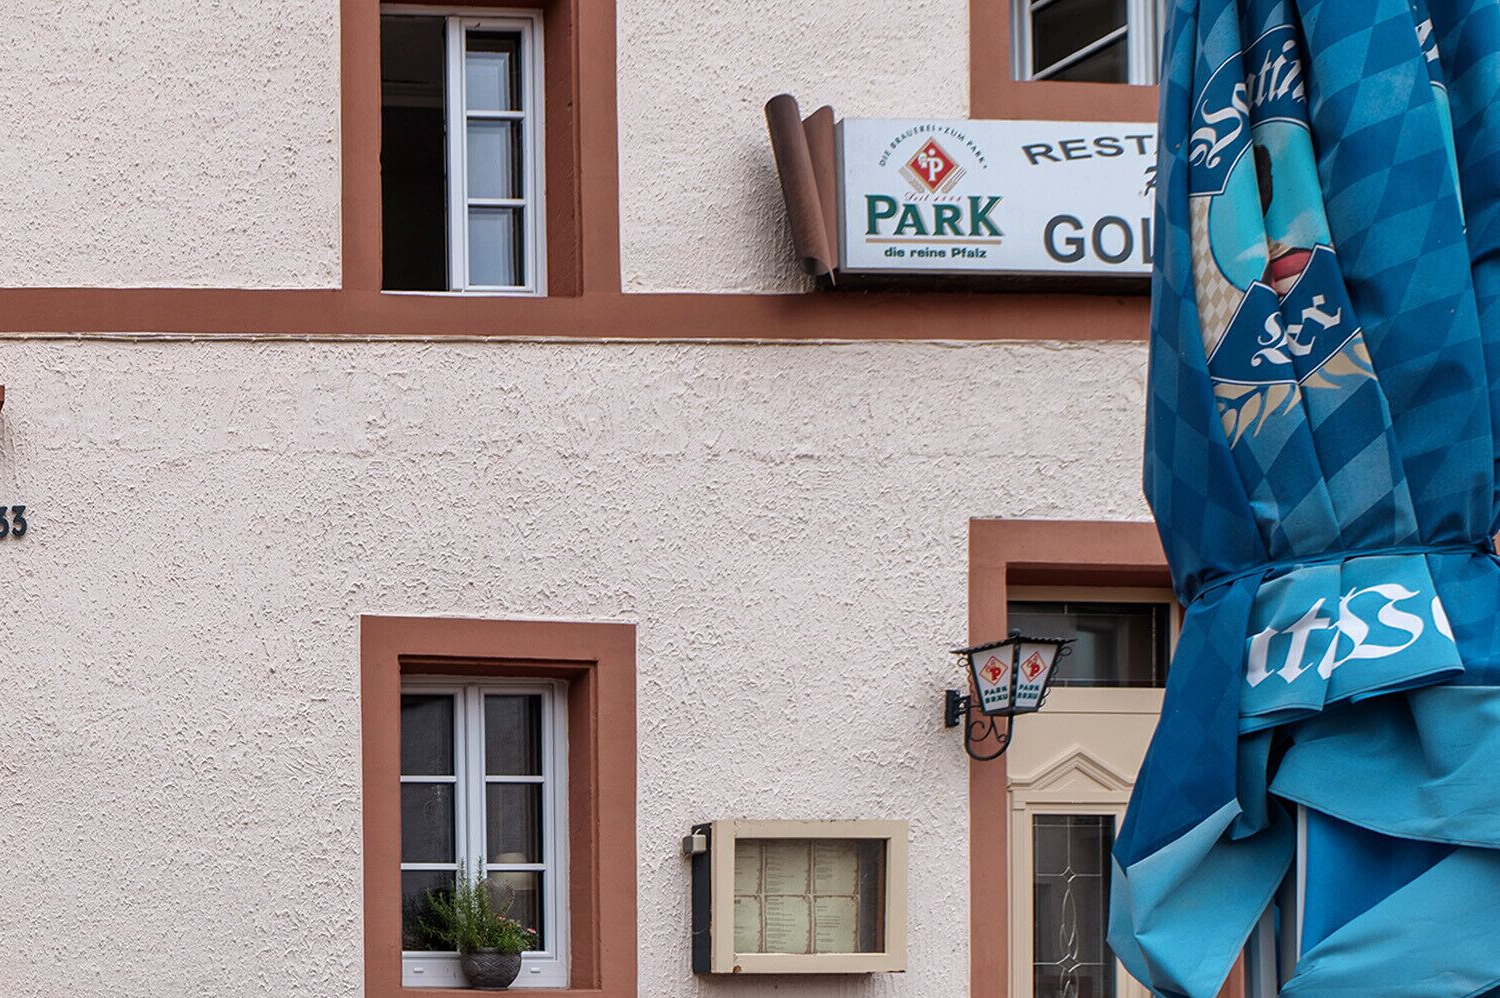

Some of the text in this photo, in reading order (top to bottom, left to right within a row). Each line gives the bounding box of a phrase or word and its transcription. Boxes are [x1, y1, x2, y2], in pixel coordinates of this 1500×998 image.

[879, 150, 891, 168] DIE
[944, 127, 965, 141] ZUM
[967, 140, 986, 163] PARK
[1021, 134, 1158, 165] REST
[864, 194, 1004, 236] PARK
[884, 246, 987, 259] die reine Pfalz
[984, 685, 1007, 696] PARK
